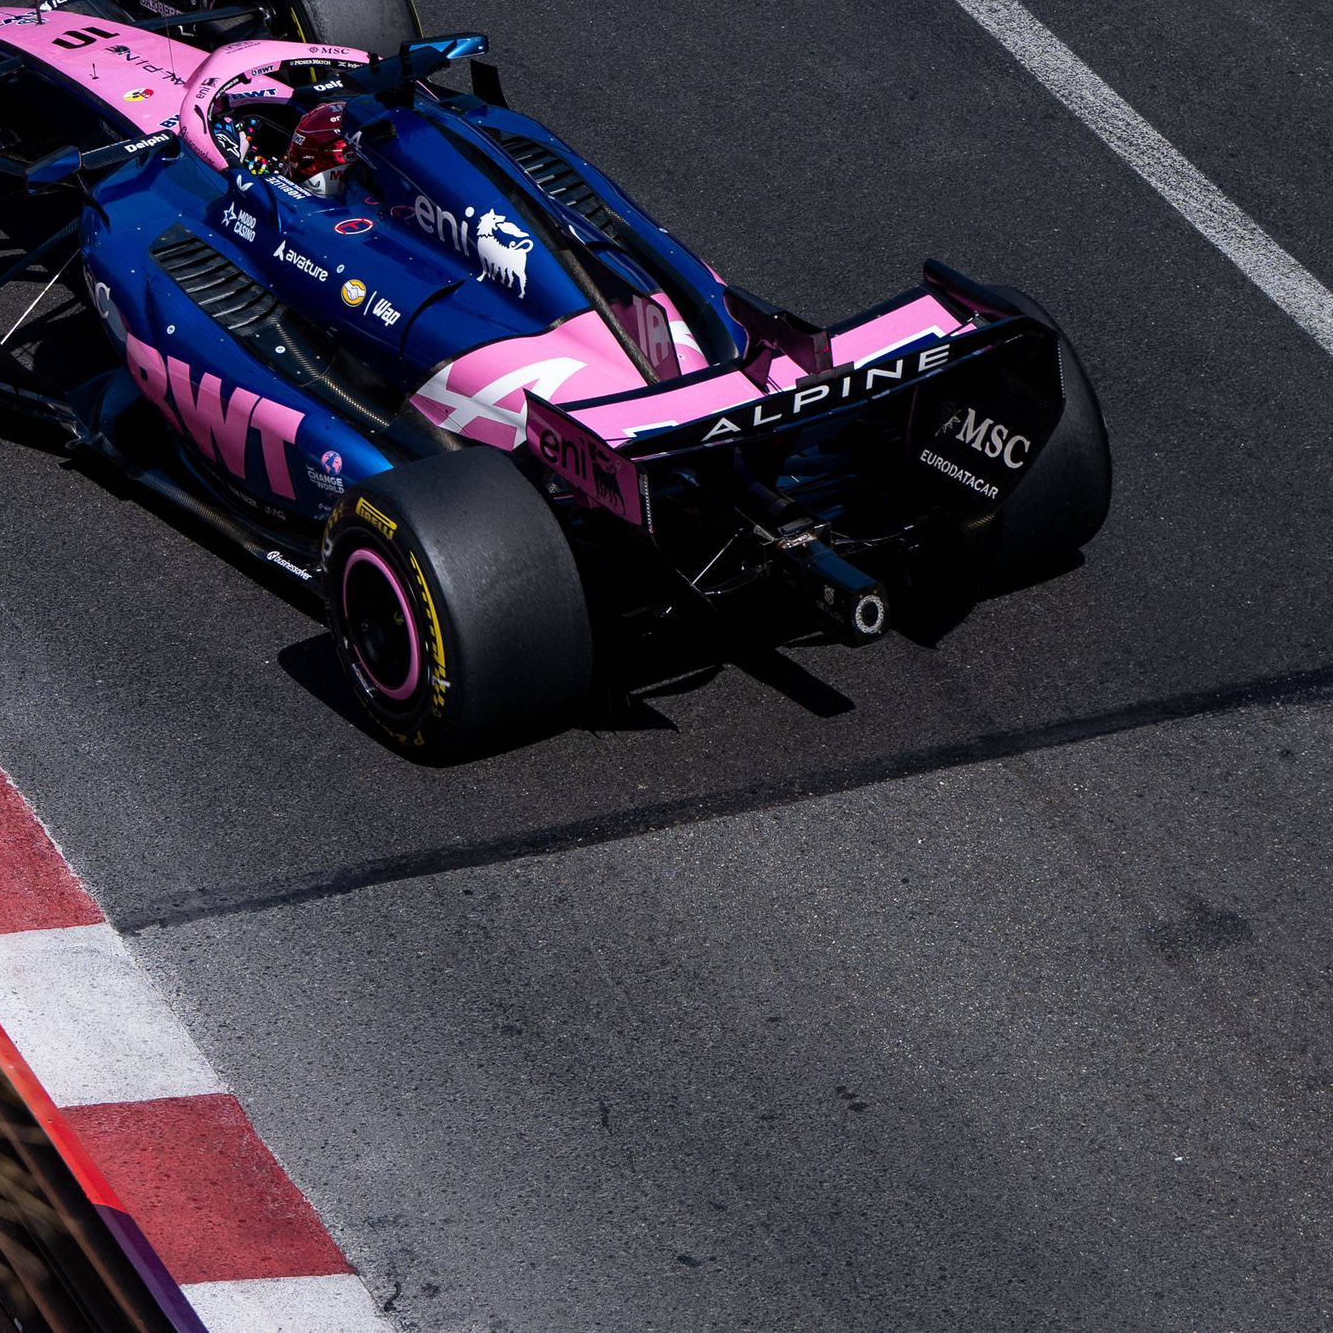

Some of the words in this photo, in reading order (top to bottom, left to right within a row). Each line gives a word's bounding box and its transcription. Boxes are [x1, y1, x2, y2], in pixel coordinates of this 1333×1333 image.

[321, 47, 350, 55] MSC
[257, 64, 274, 76] BWT
[195, 83, 211, 100] eni
[124, 133, 170, 153] Delphi
[233, 222, 256, 243] CASINO
[237, 210, 256, 228] MODO
[414, 195, 475, 257] eni
[285, 248, 329, 282] avature
[372, 297, 401, 327] Wap
[701, 343, 951, 442] ALPINE
[126, 331, 306, 501] BWT
[957, 407, 1031, 469] MSC
[539, 429, 588, 481] eni
[307, 470, 344, 487] CHANGE
[316, 481, 345, 495] WORLD
[919, 449, 999, 499] EURODATACAR
[355, 496, 398, 540] PIRELLI
